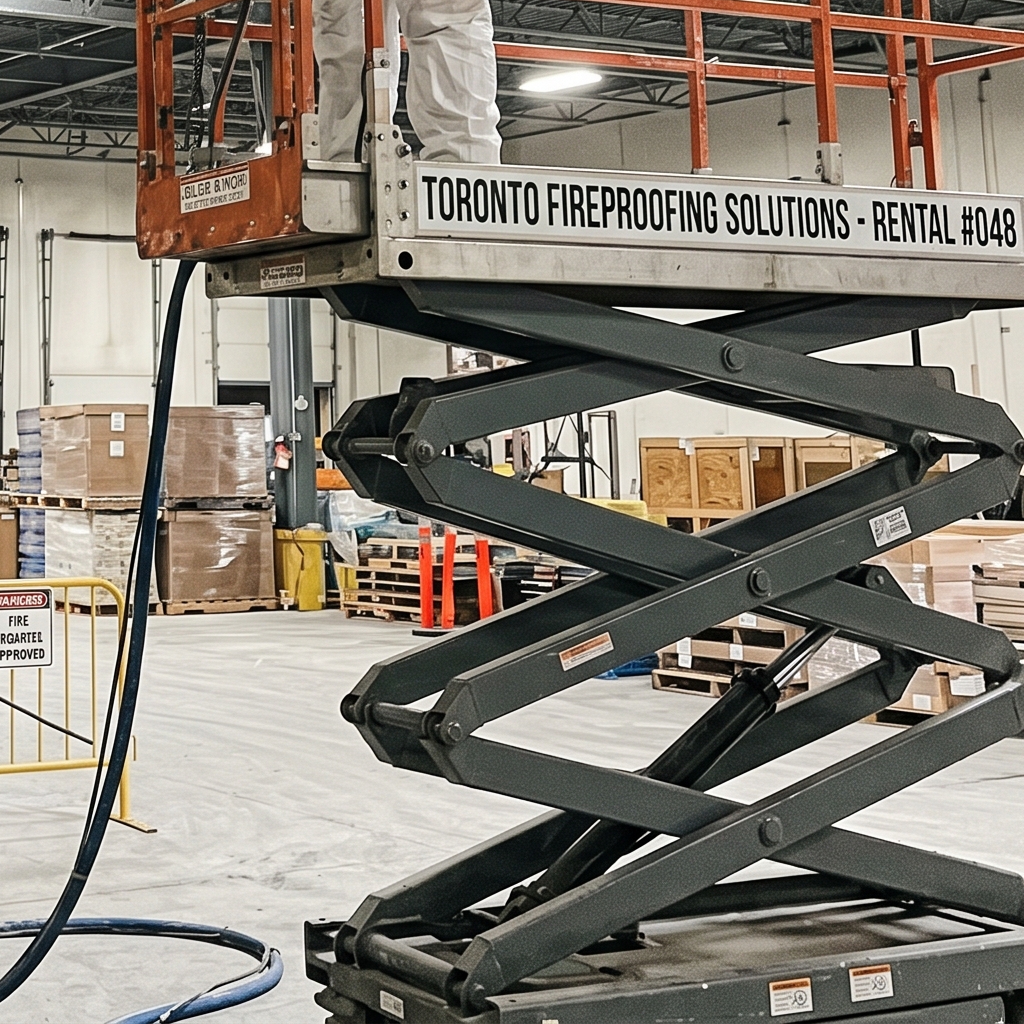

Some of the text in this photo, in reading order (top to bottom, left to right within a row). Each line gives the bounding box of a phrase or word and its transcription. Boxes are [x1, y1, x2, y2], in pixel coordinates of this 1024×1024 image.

[422, 175, 1017, 248] TORONTO FIREPROOFING SOLUTIONS - RENTAL #048
[9, 615, 29, 627] FIRE
